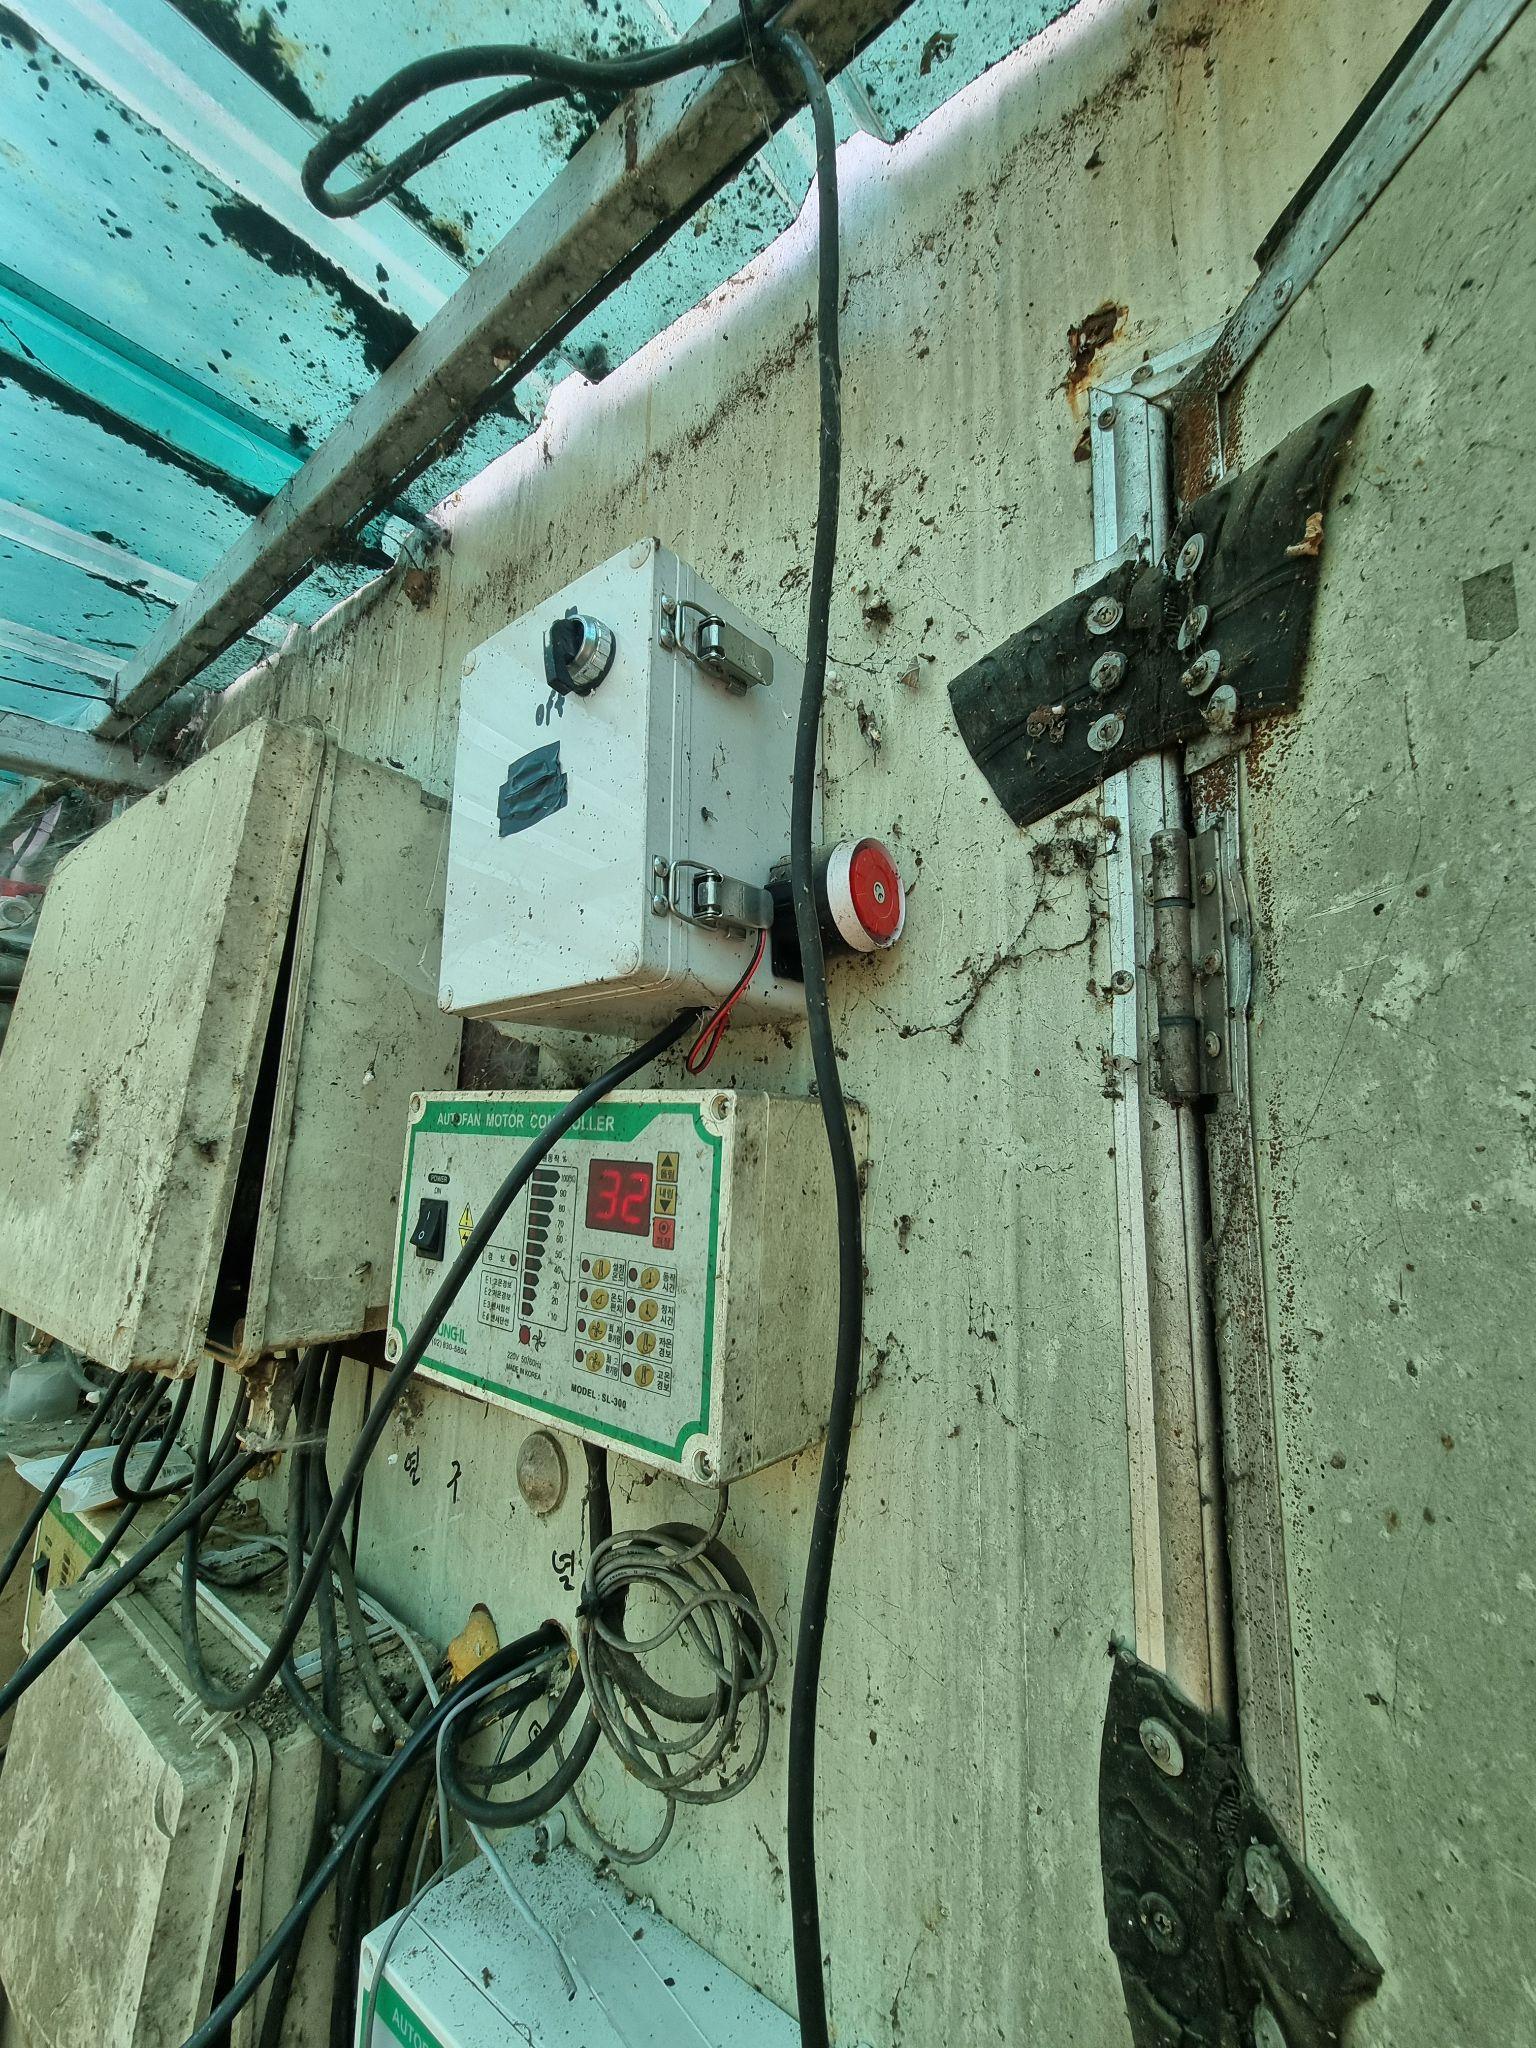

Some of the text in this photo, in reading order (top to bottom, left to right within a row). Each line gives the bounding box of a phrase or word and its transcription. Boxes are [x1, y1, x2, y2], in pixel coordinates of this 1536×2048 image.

[437, 1112, 481, 1127] AUTOFAN
[486, 1113, 524, 1129] MOTOR
[429, 1174, 449, 1184] POWER
[434, 1186, 442, 1195] ON
[559, 1189, 567, 1198] 90
[596, 1169, 650, 1224] 32
[558, 1204, 566, 1213] 80
[557, 1220, 565, 1229] 70
[556, 1235, 564, 1244] 60
[554, 1251, 563, 1260] 50
[425, 1267, 436, 1277] OFF
[553, 1266, 561, 1275] 40
[552, 1281, 560, 1290] 30
[661, 1282, 675, 1294] 시간
[551, 1297, 559, 1306] 20
[550, 1312, 558, 1322] 10
[505, 1362, 520, 1374] MADE
[525, 1369, 542, 1382] KOREA
[571, 1383, 596, 1400] MODEL
[601, 1393, 627, 1410] SL-300
[391, 2007, 430, 2048] AUTO
